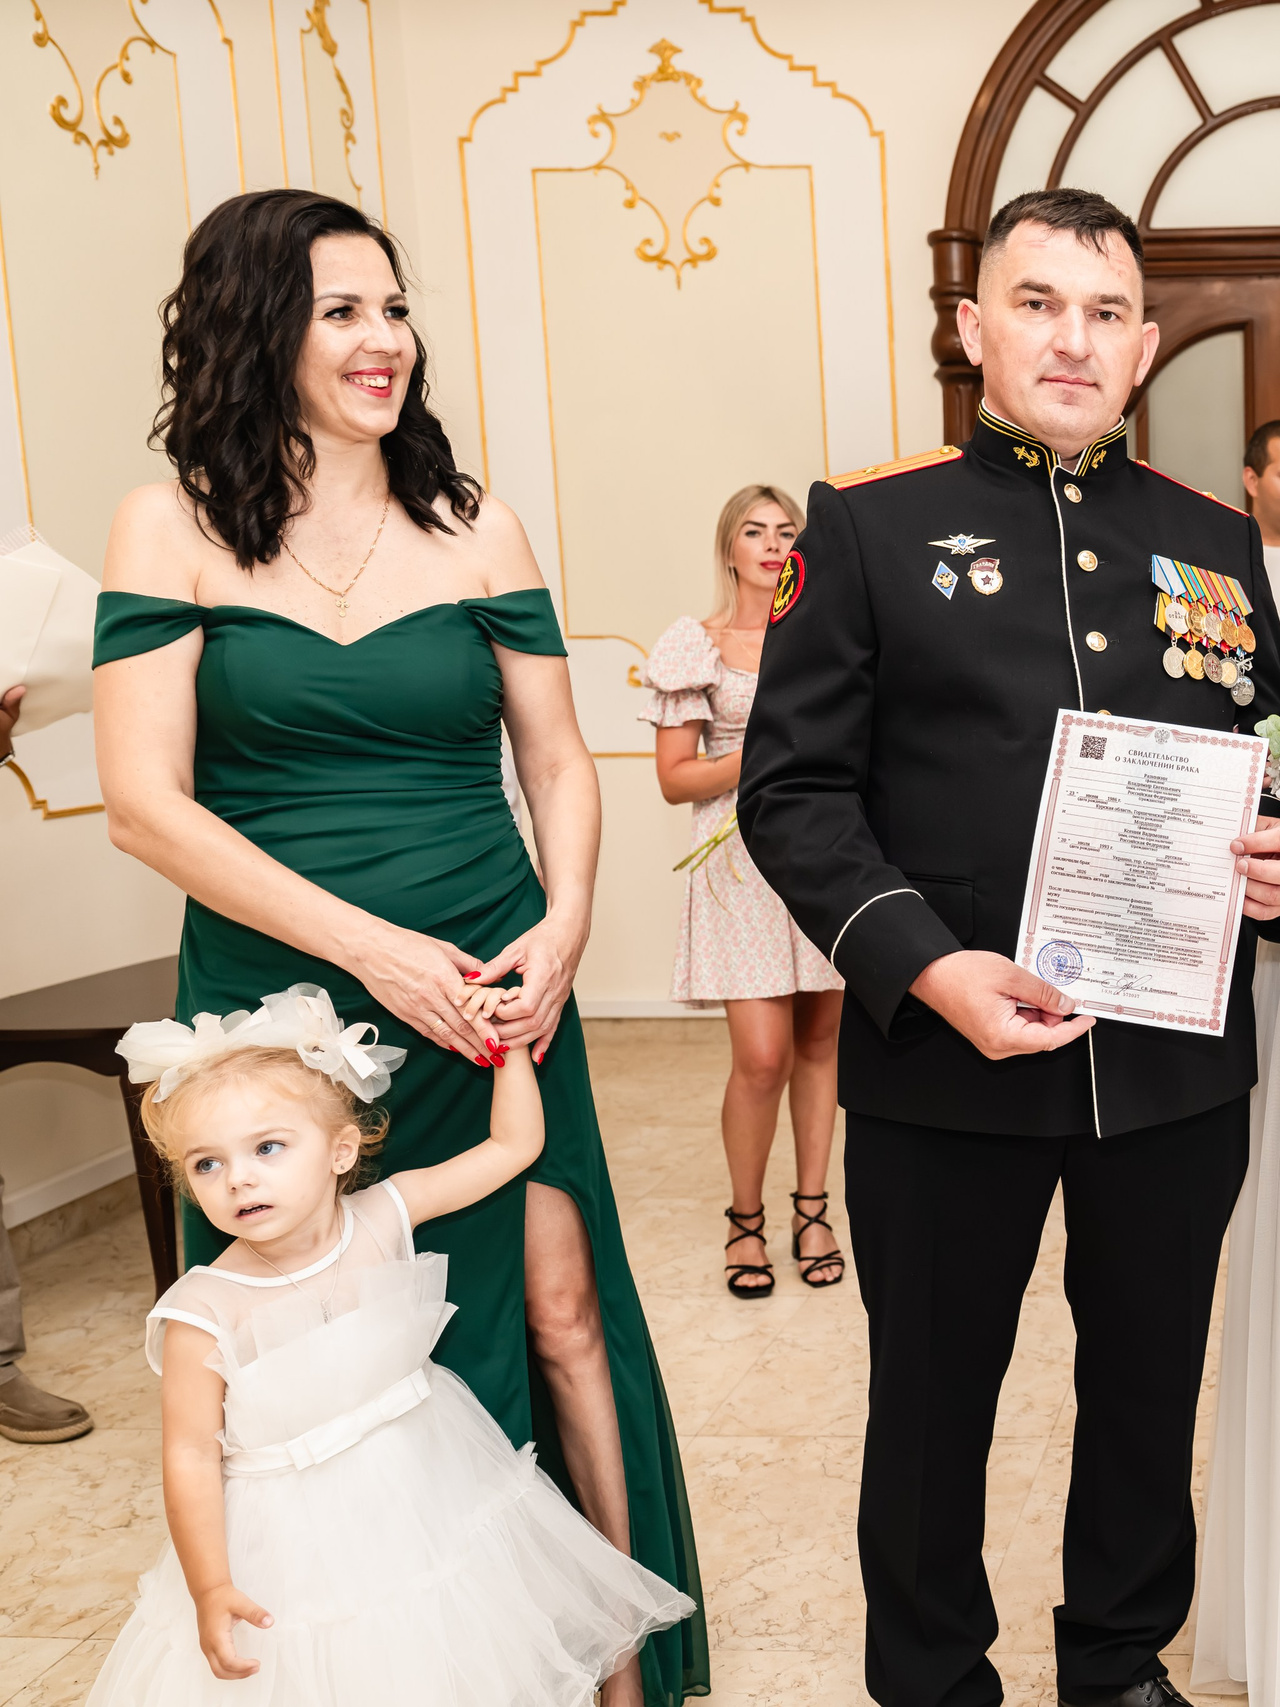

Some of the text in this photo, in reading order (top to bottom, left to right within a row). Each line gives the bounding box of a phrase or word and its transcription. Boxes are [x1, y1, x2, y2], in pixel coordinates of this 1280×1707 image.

[1128, 749, 1189, 763] СВИДЕТЕЛЬСТВО
[1122, 756, 1174, 769] ЗАКЛЮЧЕНИИ
[1175, 764, 1199, 773] БРАКА
[1127, 790, 1152, 798] Российская
[1119, 837, 1170, 849] Российская Федерация
